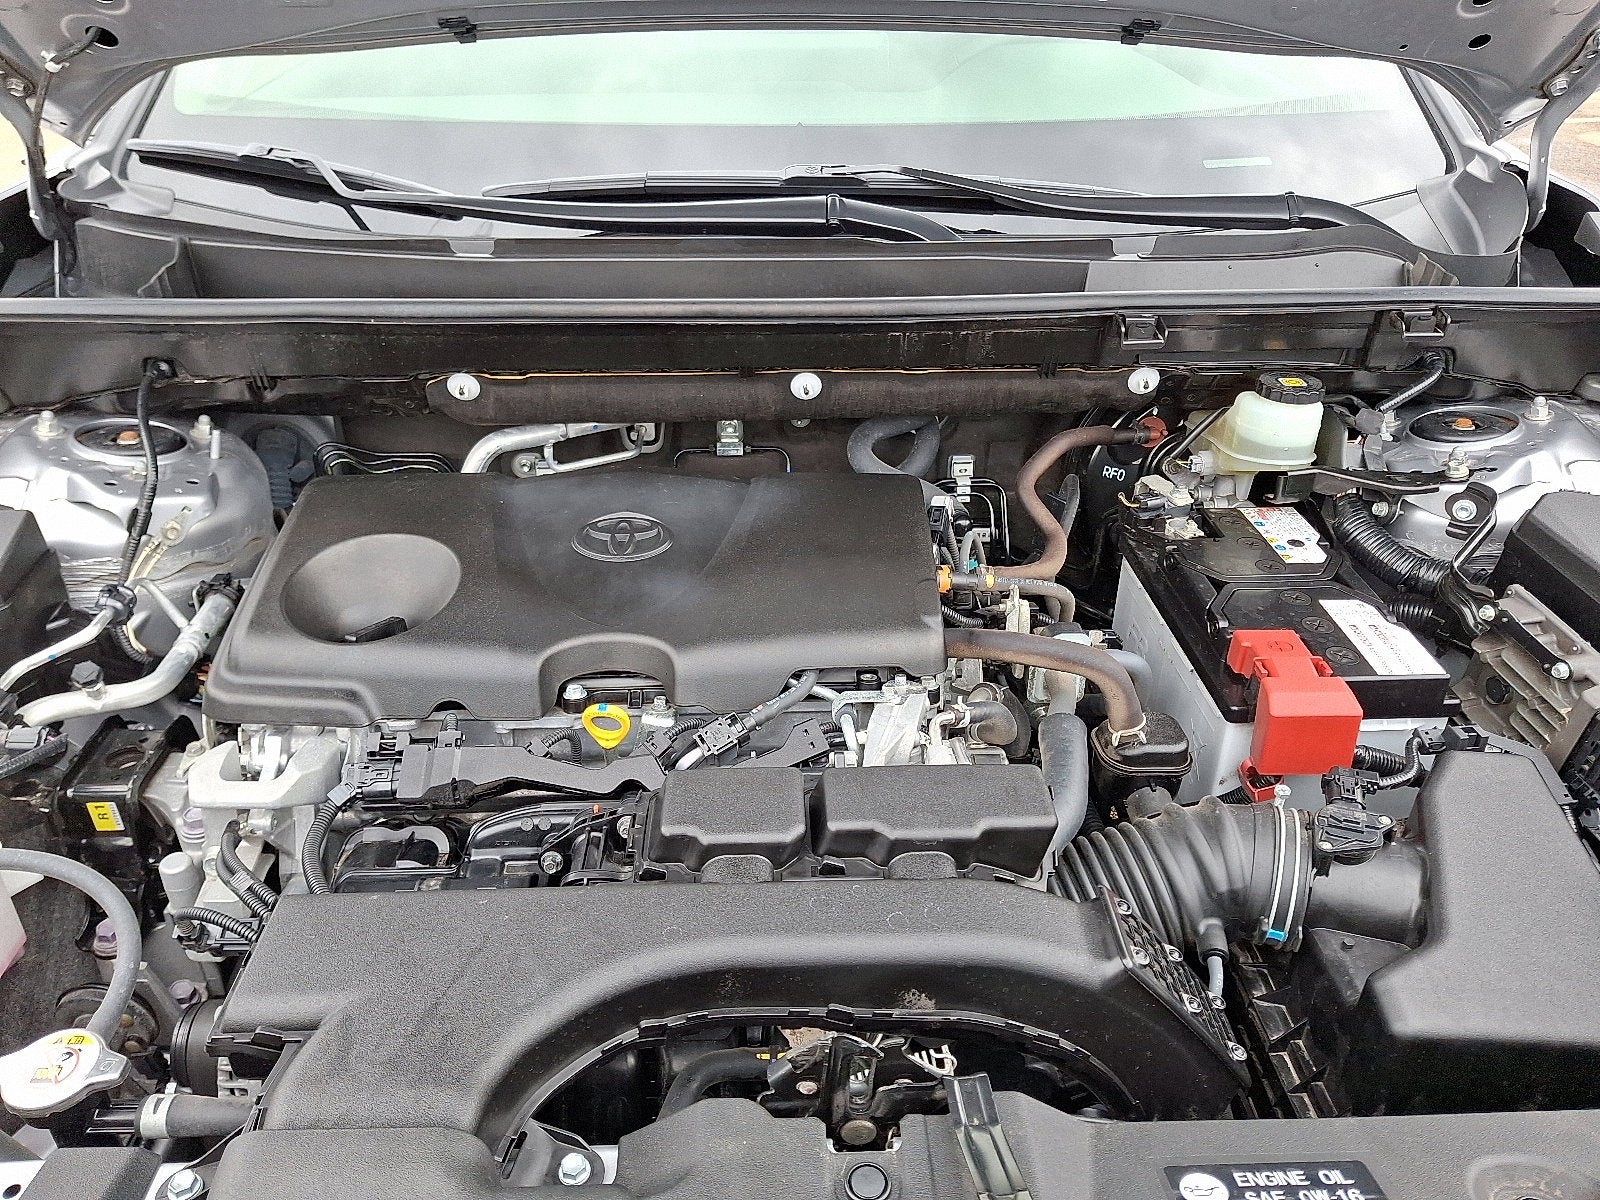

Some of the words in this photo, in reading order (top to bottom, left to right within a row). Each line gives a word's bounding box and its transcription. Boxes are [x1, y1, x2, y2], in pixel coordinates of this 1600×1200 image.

[1232, 1170, 1311, 1188] ENGINE
[1317, 1169, 1356, 1185] OIL
[1244, 1190, 1286, 1200] SAE
